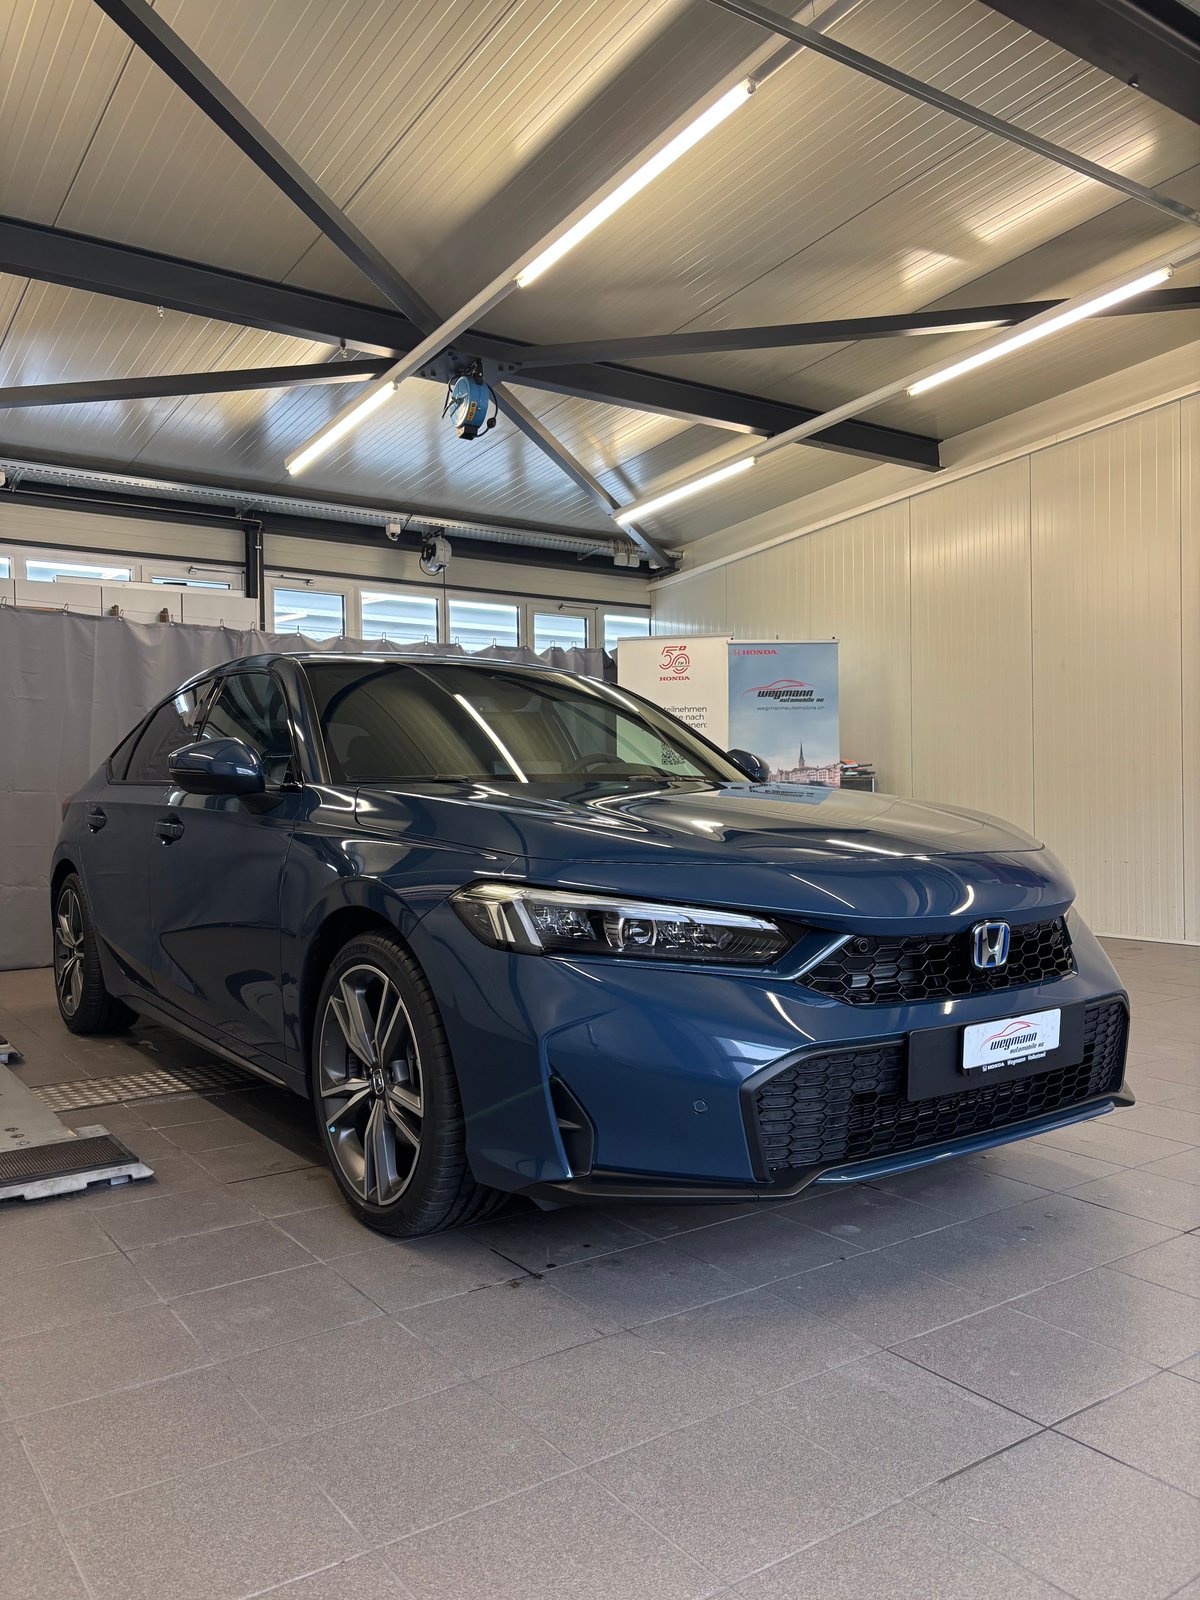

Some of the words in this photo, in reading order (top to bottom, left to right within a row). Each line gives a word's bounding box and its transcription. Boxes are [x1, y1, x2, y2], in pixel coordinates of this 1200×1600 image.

[757, 690, 814, 699] wegmann
[990, 1032, 1038, 1051] wegmann
[987, 1062, 1005, 1070] HONDA
